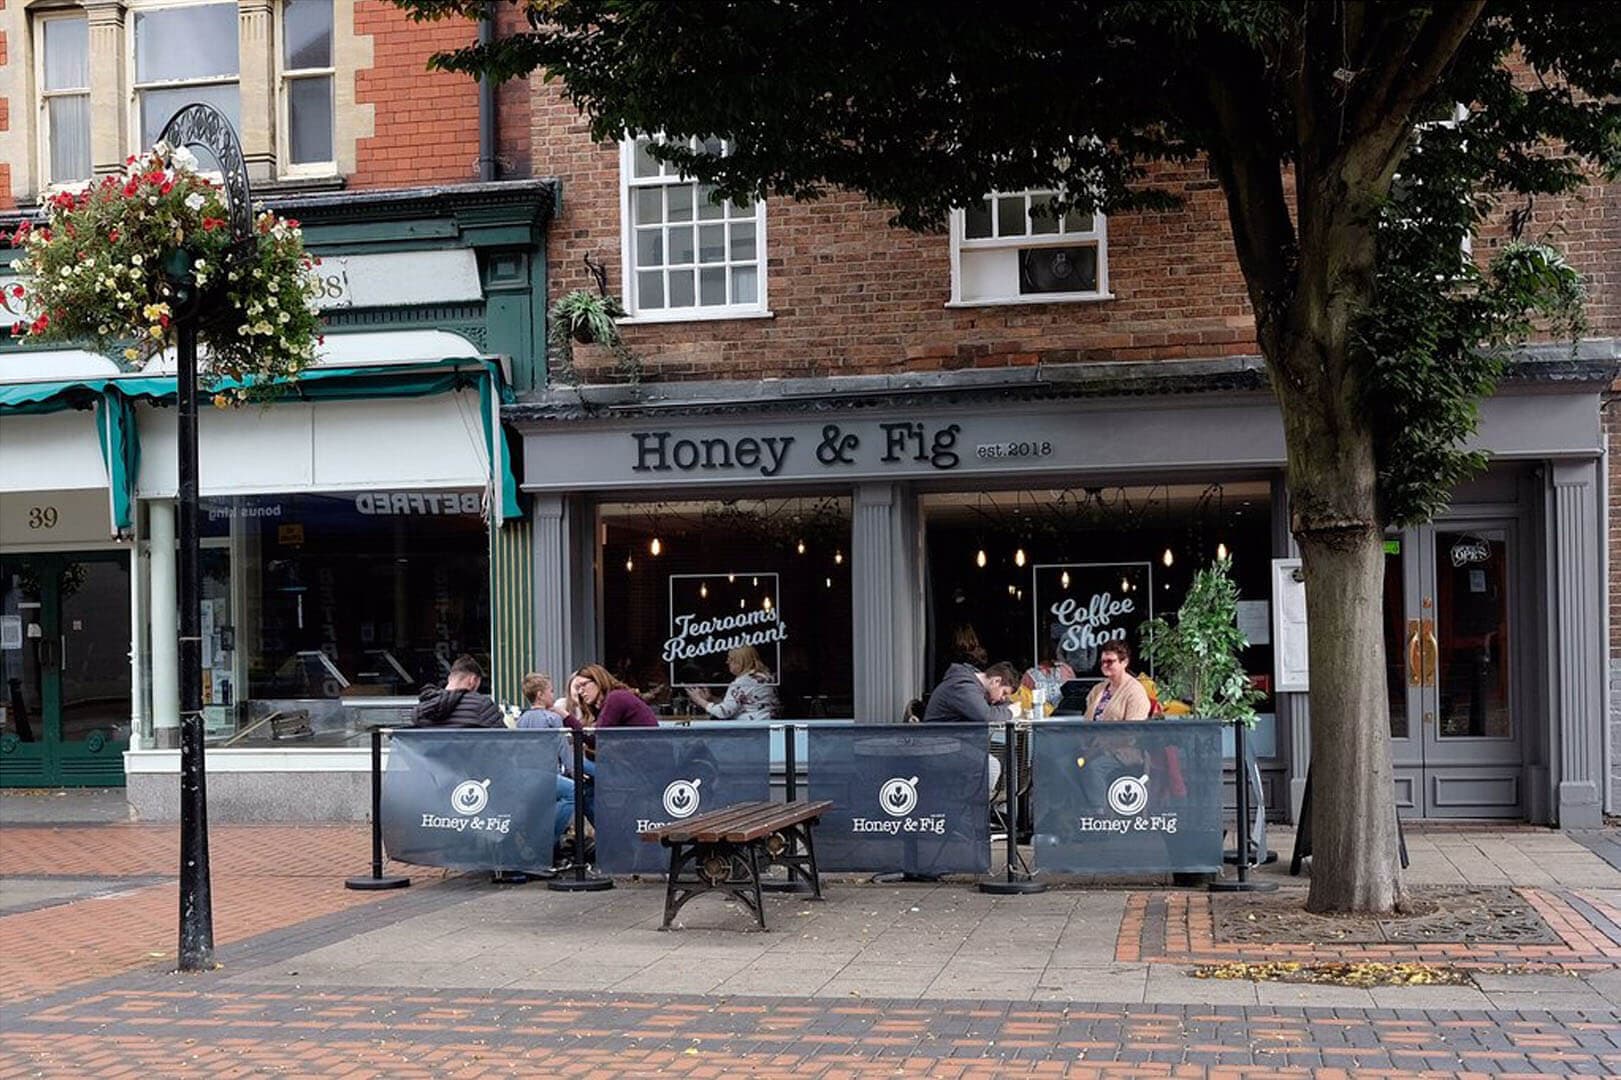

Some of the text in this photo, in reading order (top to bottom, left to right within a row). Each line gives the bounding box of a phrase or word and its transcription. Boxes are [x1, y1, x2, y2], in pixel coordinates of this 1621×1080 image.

[631, 432, 795, 477] Honey
[816, 424, 859, 464] &
[879, 422, 961, 469] Fig
[29, 506, 58, 529] 39
[675, 607, 777, 639] Tearooms
[1050, 592, 1135, 627] Coffee
[662, 621, 788, 662] Restaurant
[421, 814, 511, 834] Honey & Fig
[852, 817, 945, 835] Honey & Fig
[1080, 816, 1178, 834] Honey & Fig
